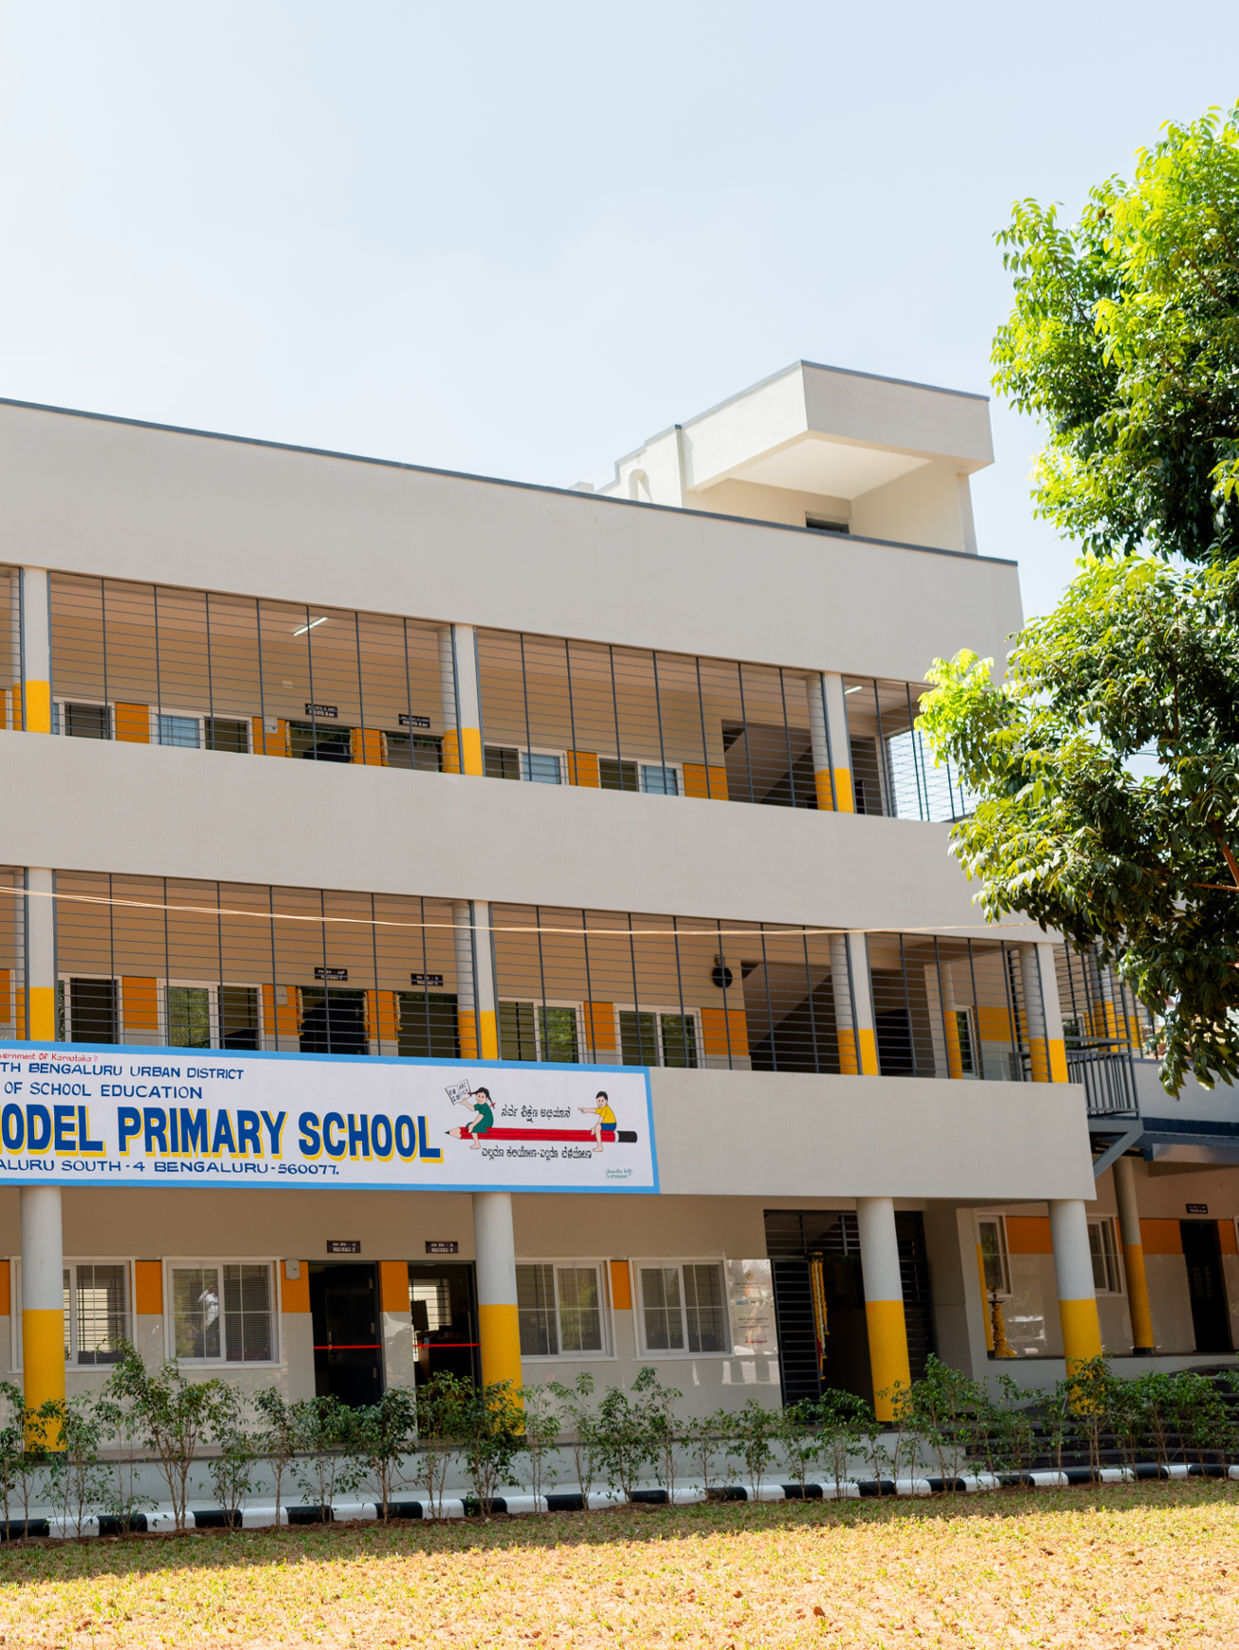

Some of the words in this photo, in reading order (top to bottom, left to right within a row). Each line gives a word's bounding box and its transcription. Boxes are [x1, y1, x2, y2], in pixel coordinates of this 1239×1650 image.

[28, 1063, 122, 1077] BENGALURU
[130, 1066, 181, 1078] URBAN
[186, 1067, 244, 1079] DISTRICT
[4, 1081, 23, 1094] OF
[29, 1082, 92, 1097] SCHOOL
[100, 1084, 203, 1100] EDUCATION
[117, 1106, 289, 1160] PRIMARY
[298, 1111, 444, 1164] SCHOOL
